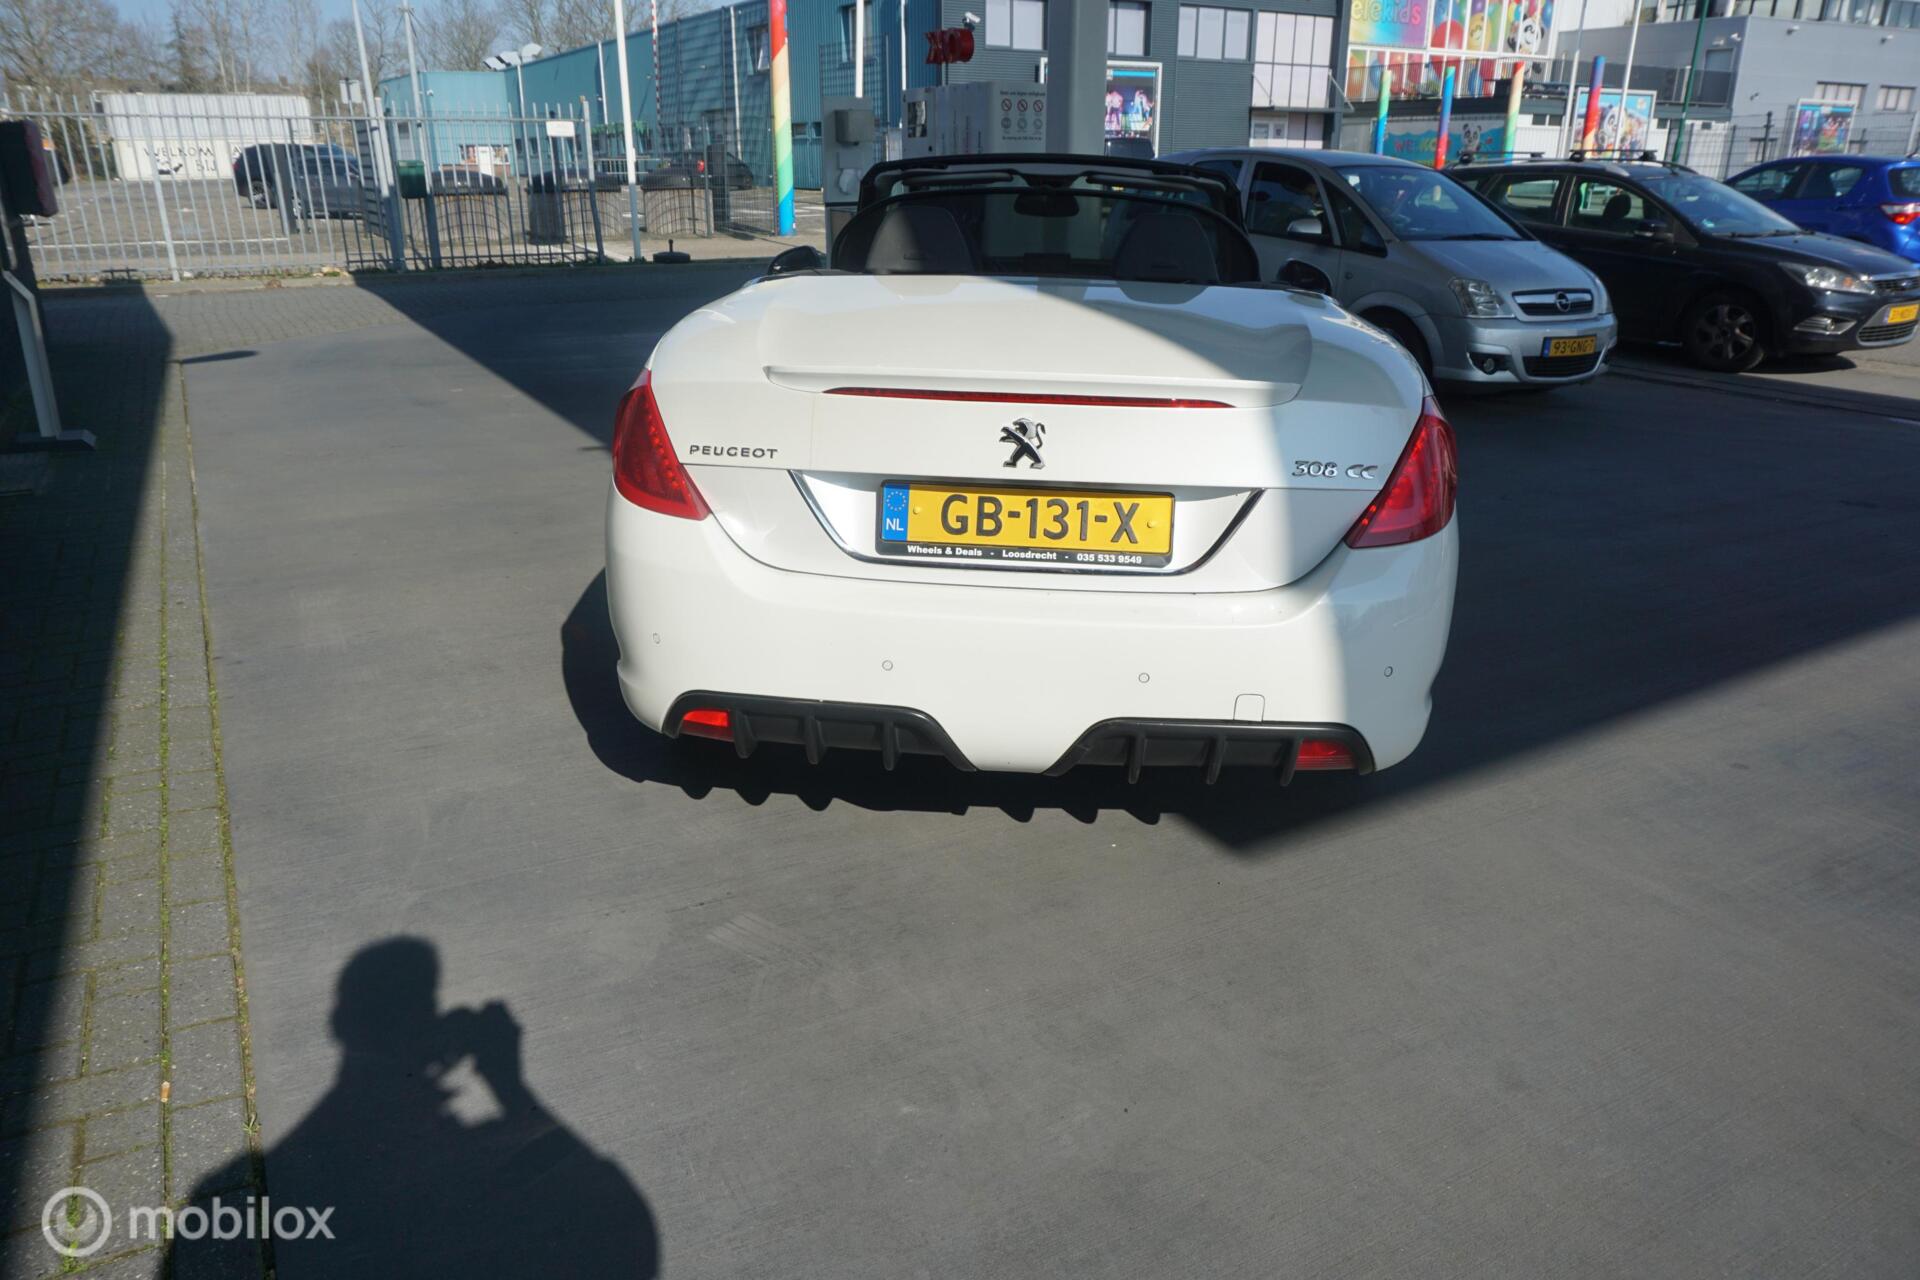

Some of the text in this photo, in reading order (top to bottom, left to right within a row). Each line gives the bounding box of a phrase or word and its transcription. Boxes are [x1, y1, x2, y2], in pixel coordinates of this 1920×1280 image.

[689, 445, 778, 459] PEUGEOT
[1292, 460, 1378, 480] 308 CC
[885, 517, 904, 532] NL
[940, 493, 1140, 544] GB-131-X
[907, 545, 942, 555] Wheels
[945, 547, 953, 555] &
[955, 547, 983, 556] Deals
[1002, 549, 1057, 560] Loosdrecht
[1077, 553, 1095, 562] 035
[1097, 554, 1116, 563] 533
[1118, 555, 1143, 564] 9549
